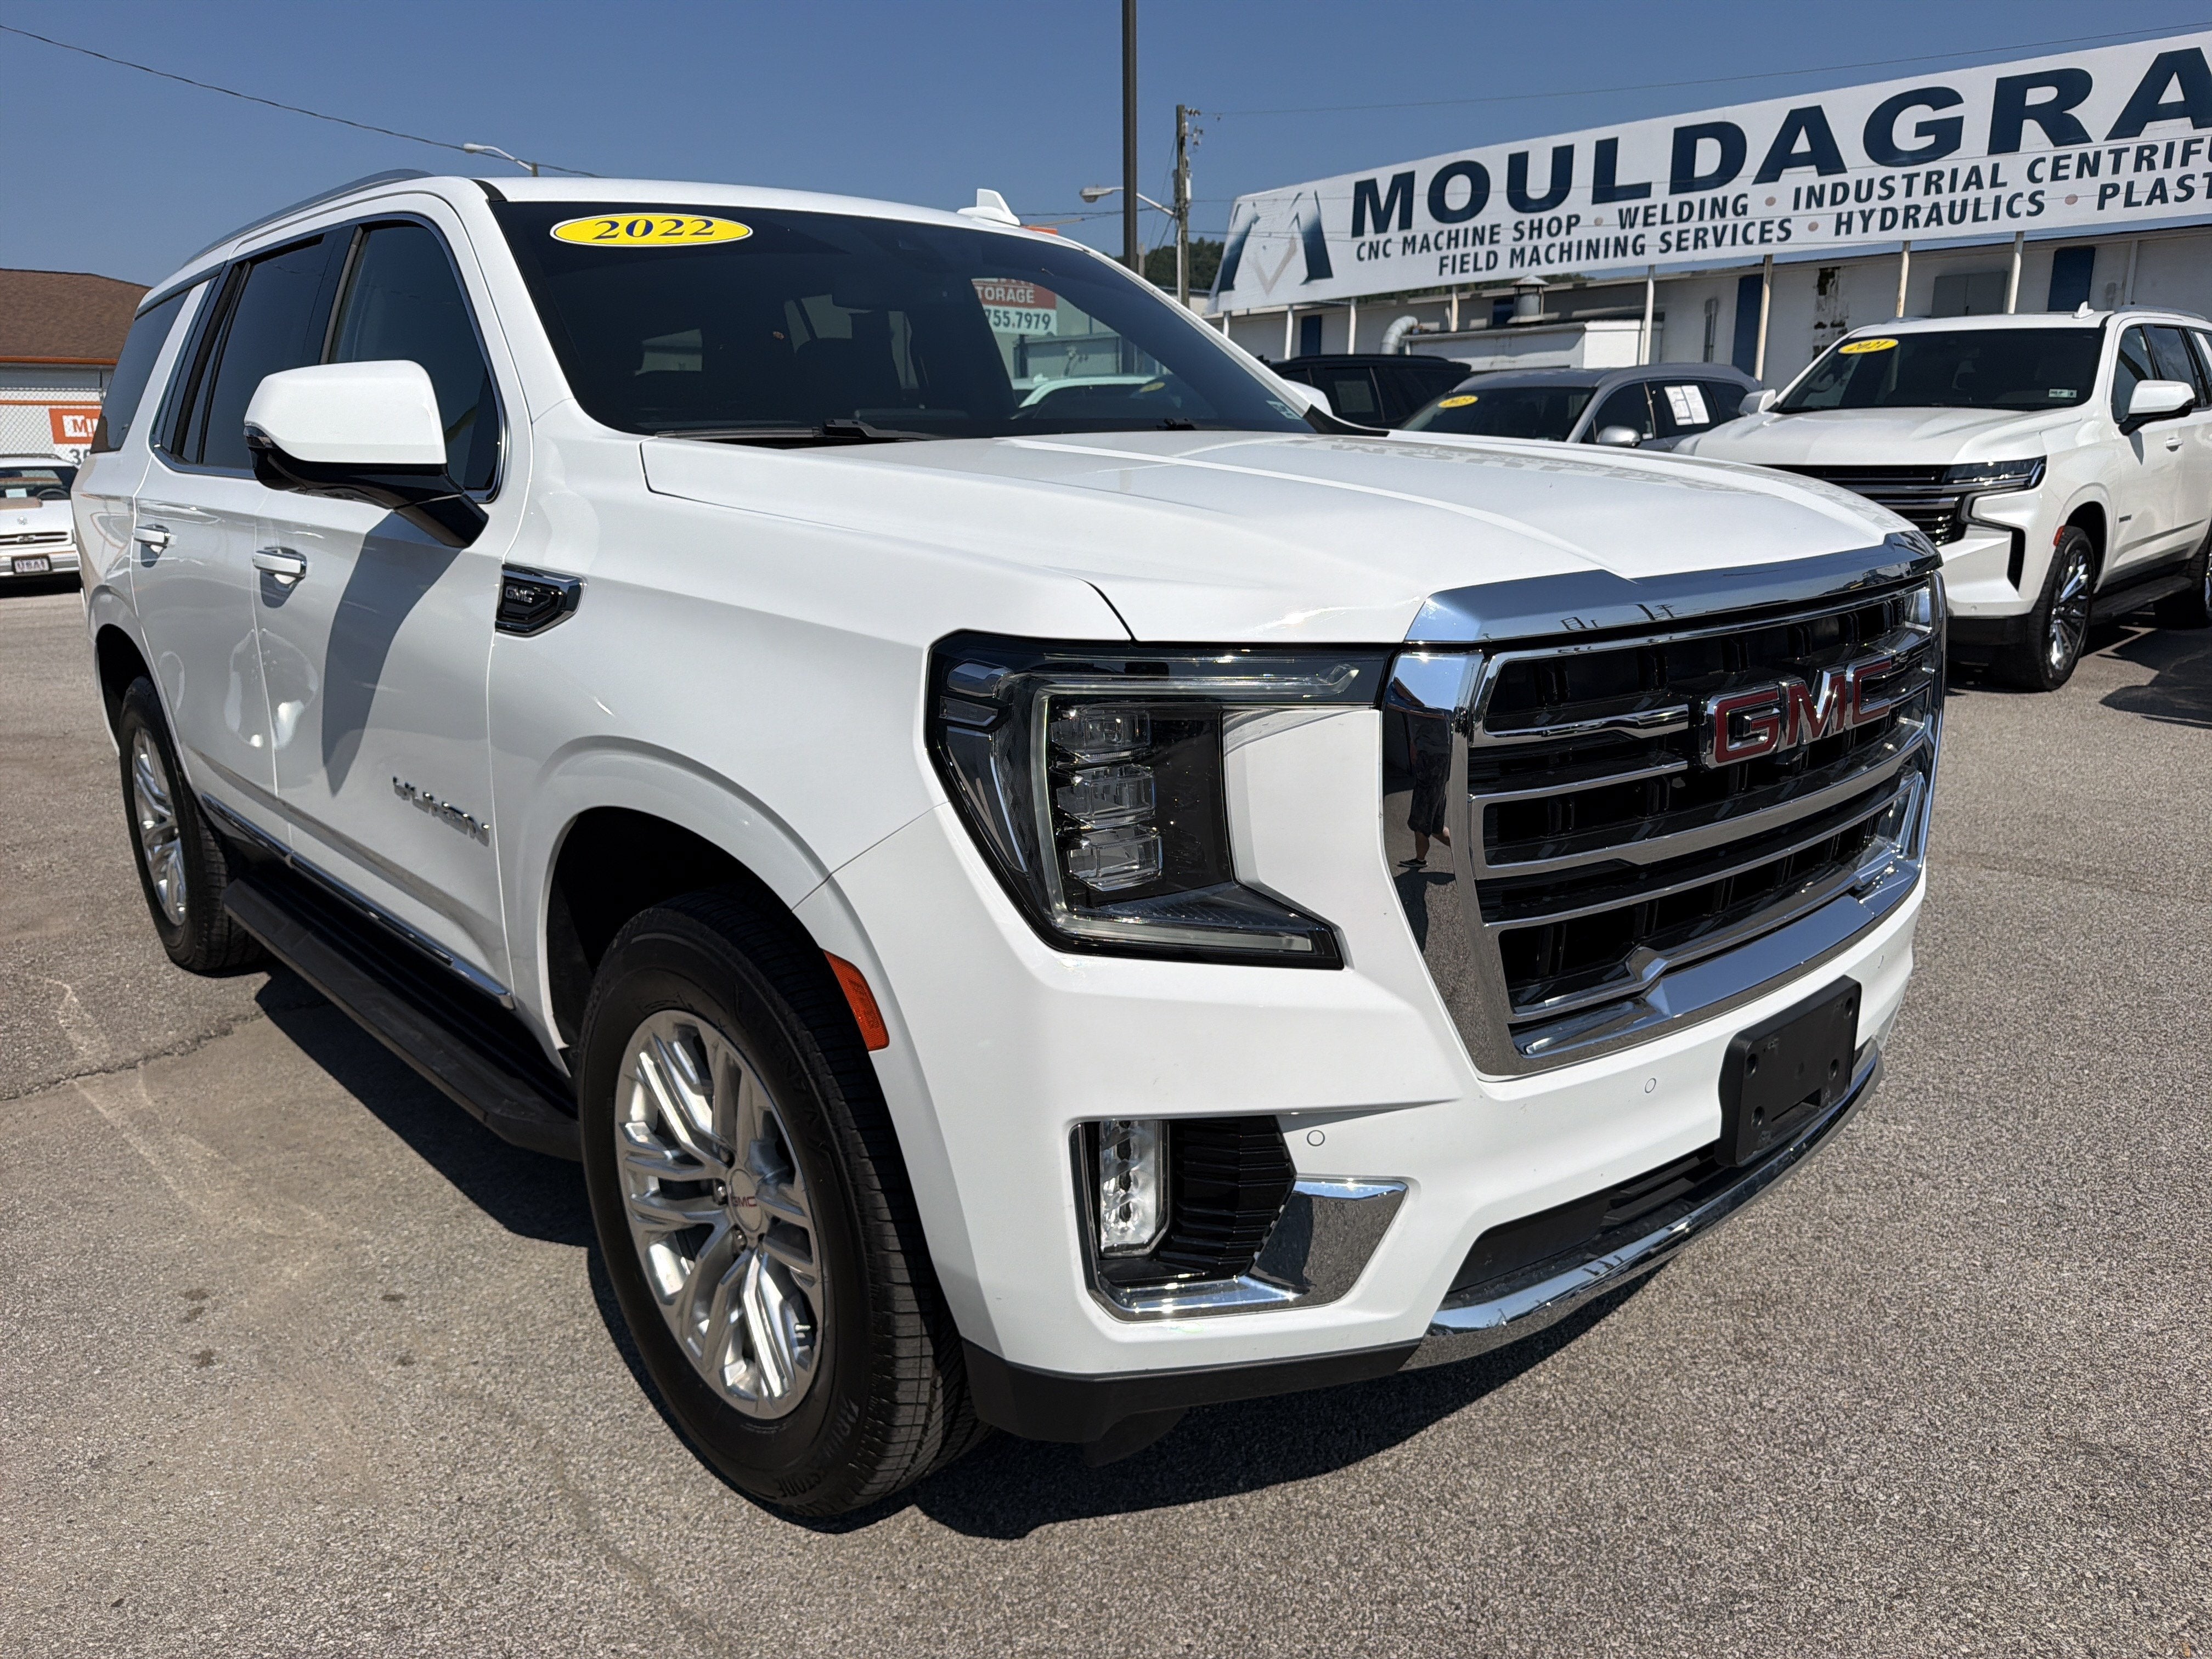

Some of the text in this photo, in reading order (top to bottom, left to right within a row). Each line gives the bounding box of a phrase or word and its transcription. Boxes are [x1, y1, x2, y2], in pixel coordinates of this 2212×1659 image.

[1351, 47, 2211, 238] MOULDAGRA
[592, 218, 715, 240] 2022
[1357, 137, 2211, 261] CNC MACHINE SHOP WELDING INDUSTRIAL CENTRIF
[1439, 251, 1498, 276] FIELD
[1510, 234, 1645, 268] MACHINING
[1659, 218, 1792, 254] SERVICES
[1835, 190, 2045, 236] HYDRAULICS
[505, 585, 535, 603] GMC
[1701, 659, 1892, 769] GMC
[731, 1196, 757, 1207] GMC
